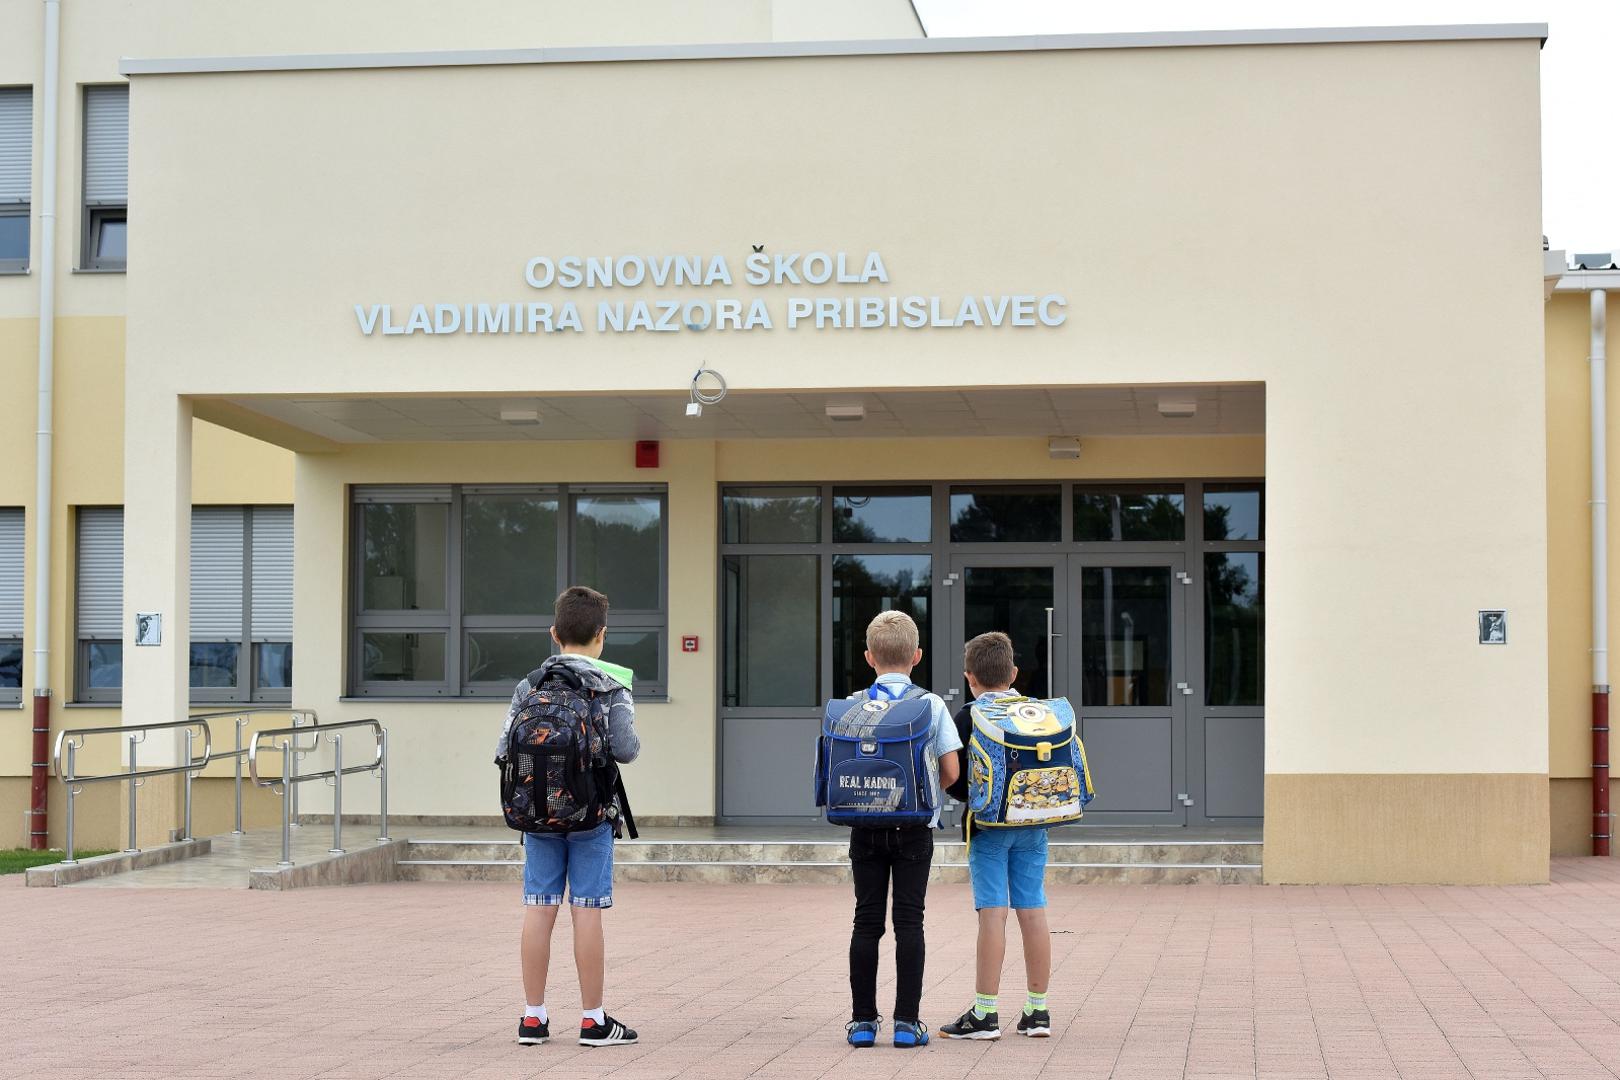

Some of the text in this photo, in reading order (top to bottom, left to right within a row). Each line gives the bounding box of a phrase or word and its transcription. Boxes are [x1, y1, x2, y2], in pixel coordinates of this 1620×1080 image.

[524, 245, 888, 289] OSNOVNA ŠKOLA
[354, 293, 1067, 335] VLADIMIRA NAZORA PRIBISLAVEC
[839, 775, 896, 789] REAL MADRID
